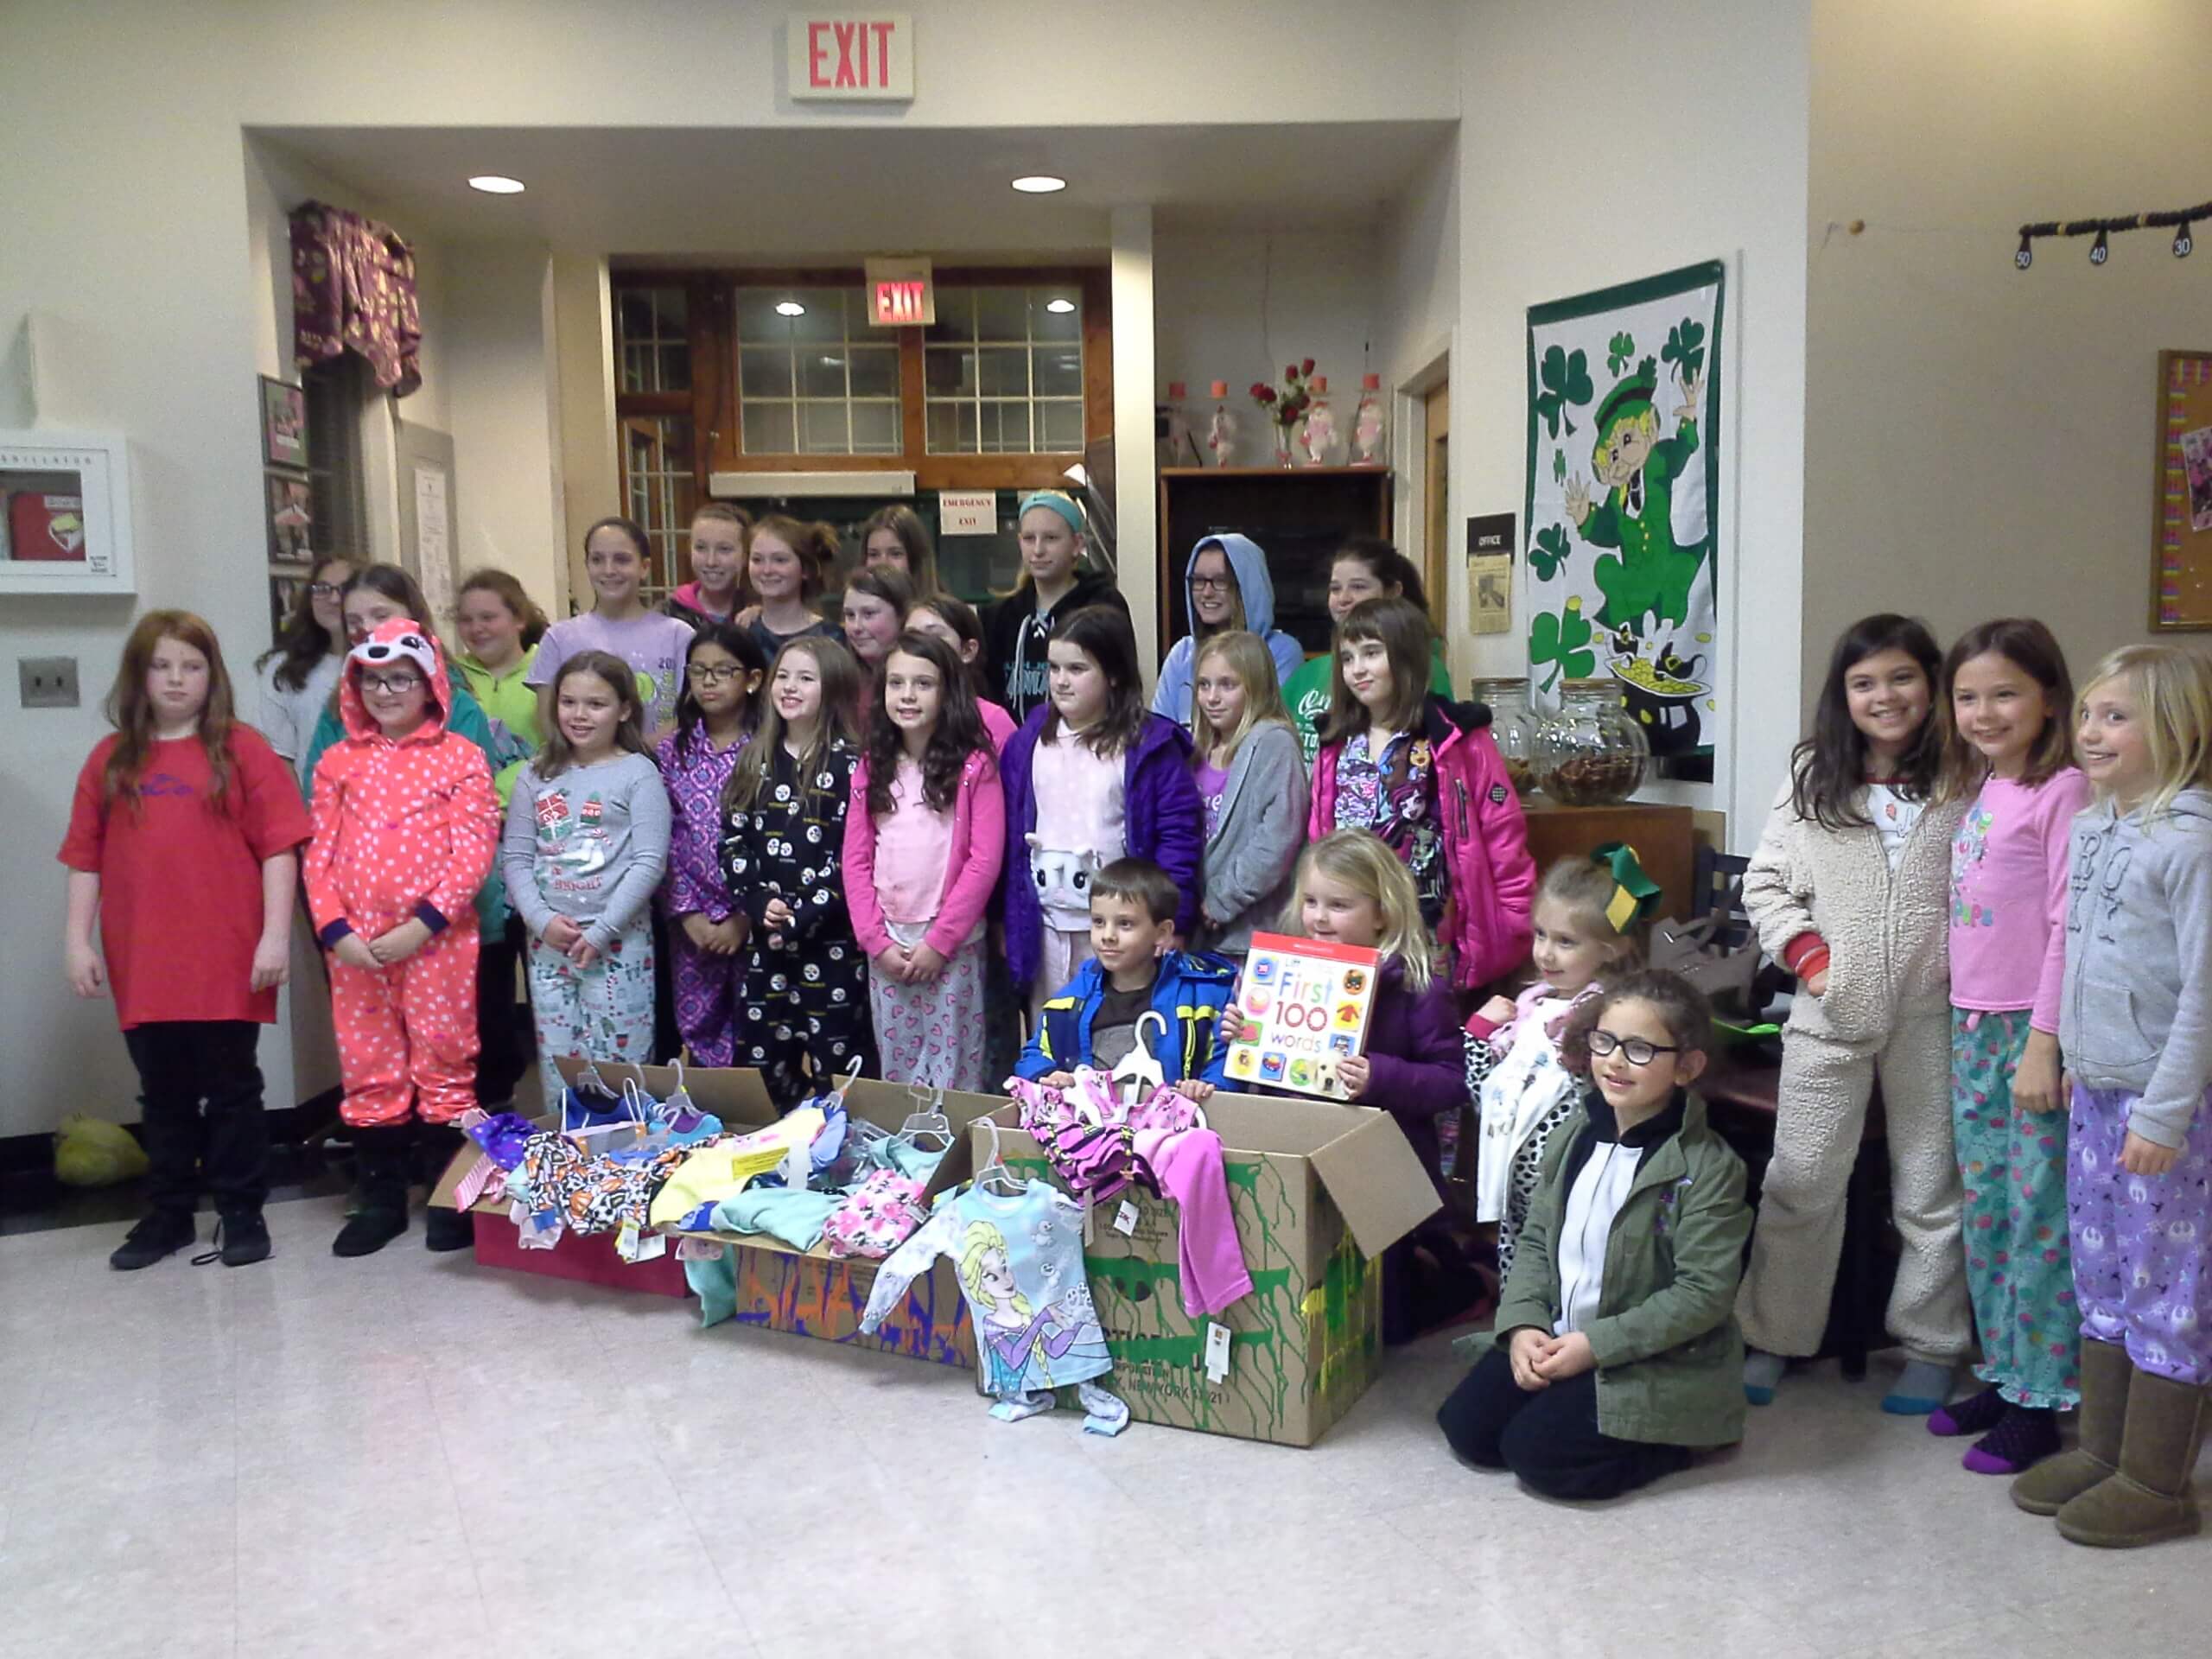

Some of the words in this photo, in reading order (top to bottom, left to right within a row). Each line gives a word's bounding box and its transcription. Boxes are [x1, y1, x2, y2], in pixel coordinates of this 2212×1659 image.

[808, 21, 895, 89] EXIT
[2091, 247, 2107, 263] 40
[2175, 238, 2190, 255] 30
[2017, 251, 2030, 267] 50
[875, 281, 925, 322] EXIT
[942, 498, 992, 508] EMERGENCY
[958, 518, 977, 526] EXIT
[1479, 535, 1501, 546] OFFICE
[1279, 971, 1335, 1005] First
[1274, 1001, 1329, 1033] 100
[1270, 1031, 1322, 1053] words
